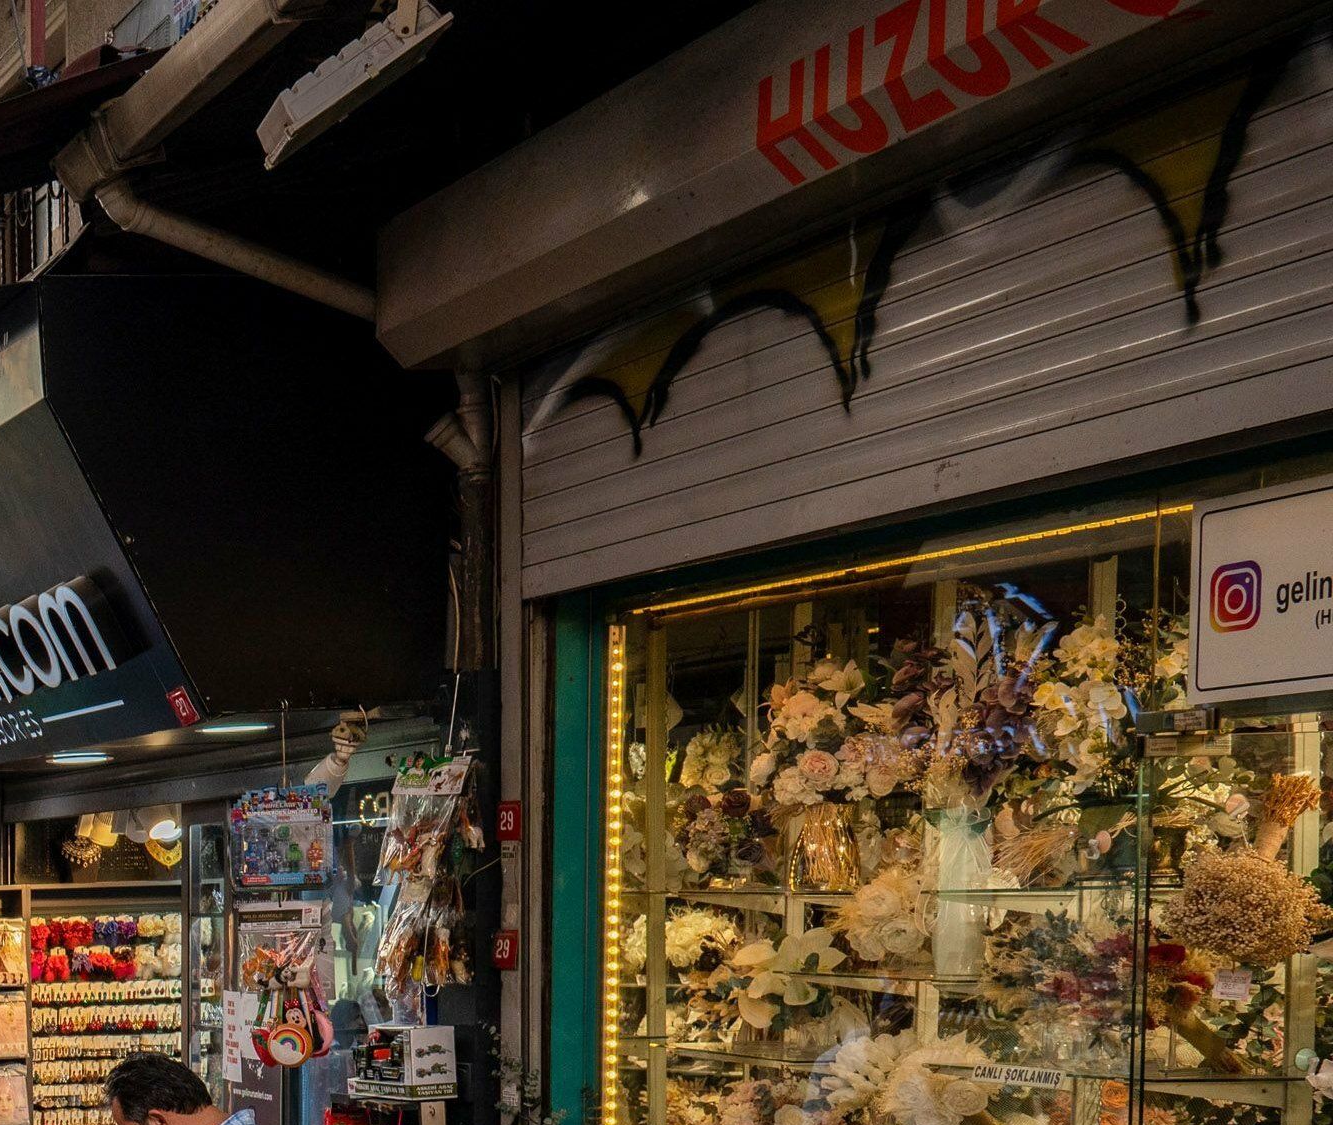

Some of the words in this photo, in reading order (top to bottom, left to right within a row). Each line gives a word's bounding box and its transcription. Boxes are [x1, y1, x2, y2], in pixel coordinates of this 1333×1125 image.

[756, 0, 1092, 186] HUZUR
[1276, 570, 1333, 614] gelin
[500, 810, 514, 831] 29
[974, 1065, 1002, 1080] CANLI
[1004, 1067, 1061, 1089] ŞOKLANMIŞ
